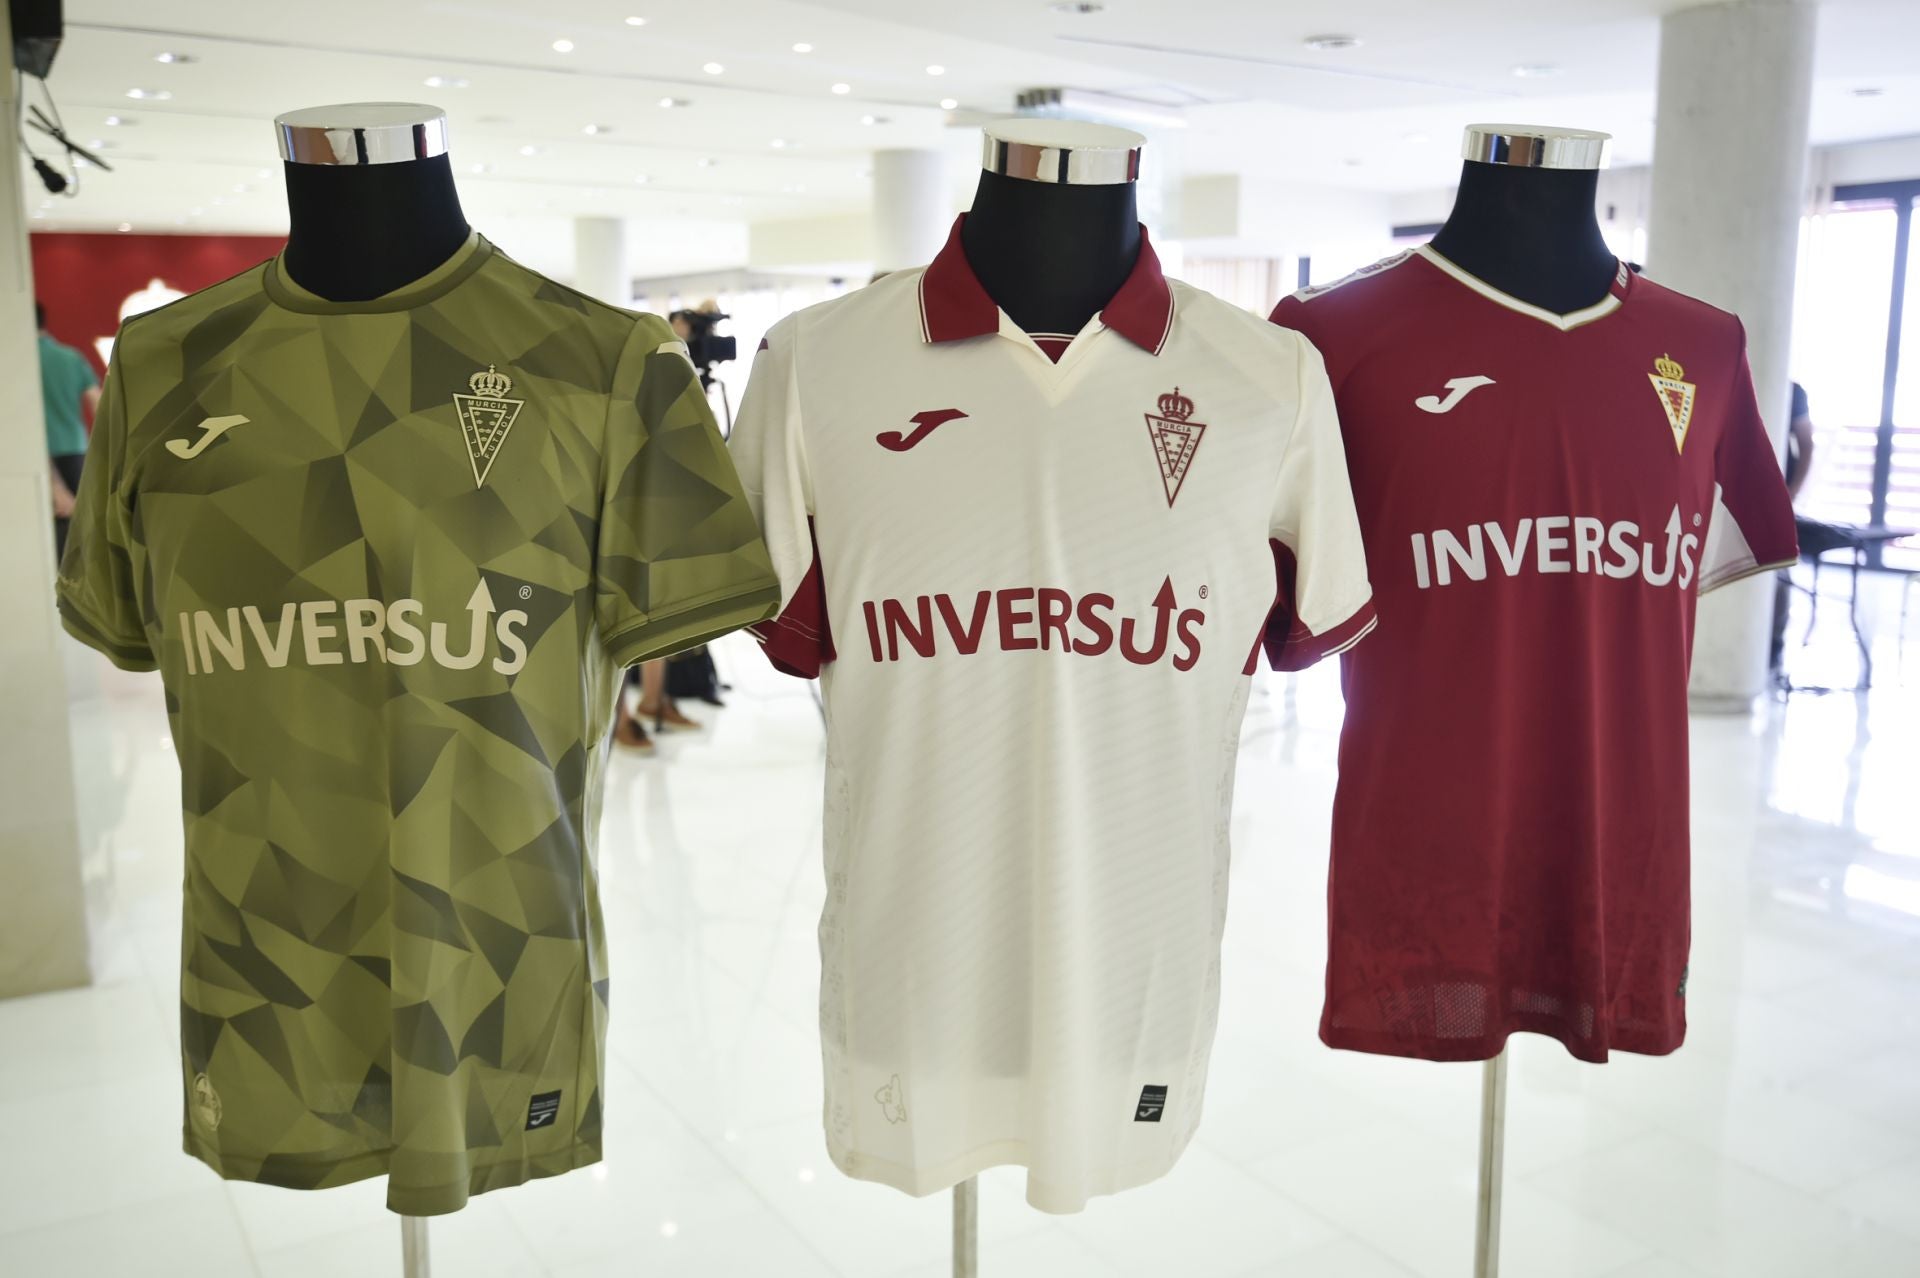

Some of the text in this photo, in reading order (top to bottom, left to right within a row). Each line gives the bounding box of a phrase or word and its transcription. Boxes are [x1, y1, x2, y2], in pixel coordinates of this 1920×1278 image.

[467, 399, 508, 410] MURCIA
[1156, 420, 1192, 433] MURCIA
[462, 411, 481, 458] CLUB
[484, 414, 512, 459] FUTBOL
[1410, 502, 1699, 590] INVERSUS
[178, 576, 529, 676] INVERSUS
[862, 573, 1206, 672] INVERSUS
